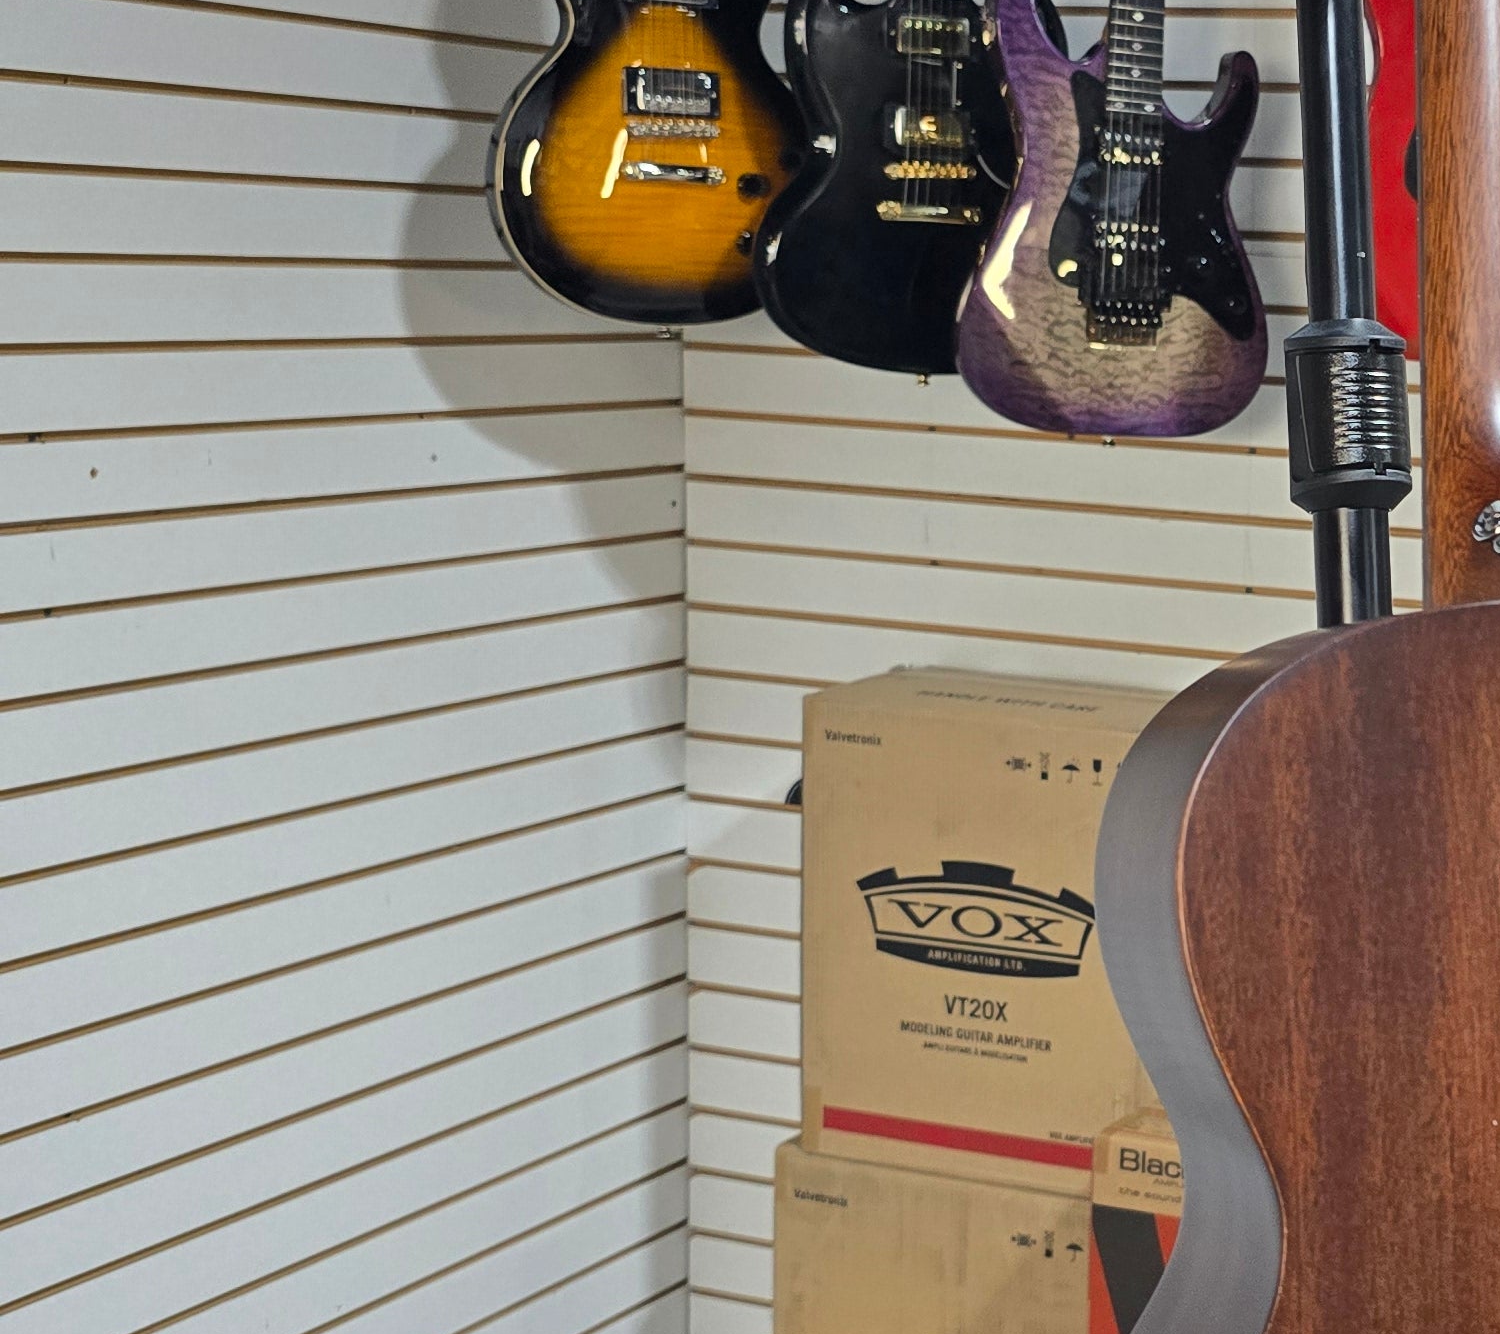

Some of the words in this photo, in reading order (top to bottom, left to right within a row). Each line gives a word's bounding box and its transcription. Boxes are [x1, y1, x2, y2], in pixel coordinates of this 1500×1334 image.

[824, 728, 883, 747] Valvetronix
[887, 898, 1064, 947] VOX
[927, 948, 1001, 968] AMPLIFICATION
[1003, 958, 1026, 972] LTD.
[944, 993, 1009, 1023] VT20X
[900, 1019, 953, 1038] MODELING
[956, 1028, 994, 1044] GUITAR
[996, 1033, 1052, 1052] AMPLIFIER
[1119, 1147, 1184, 1180] Blac
